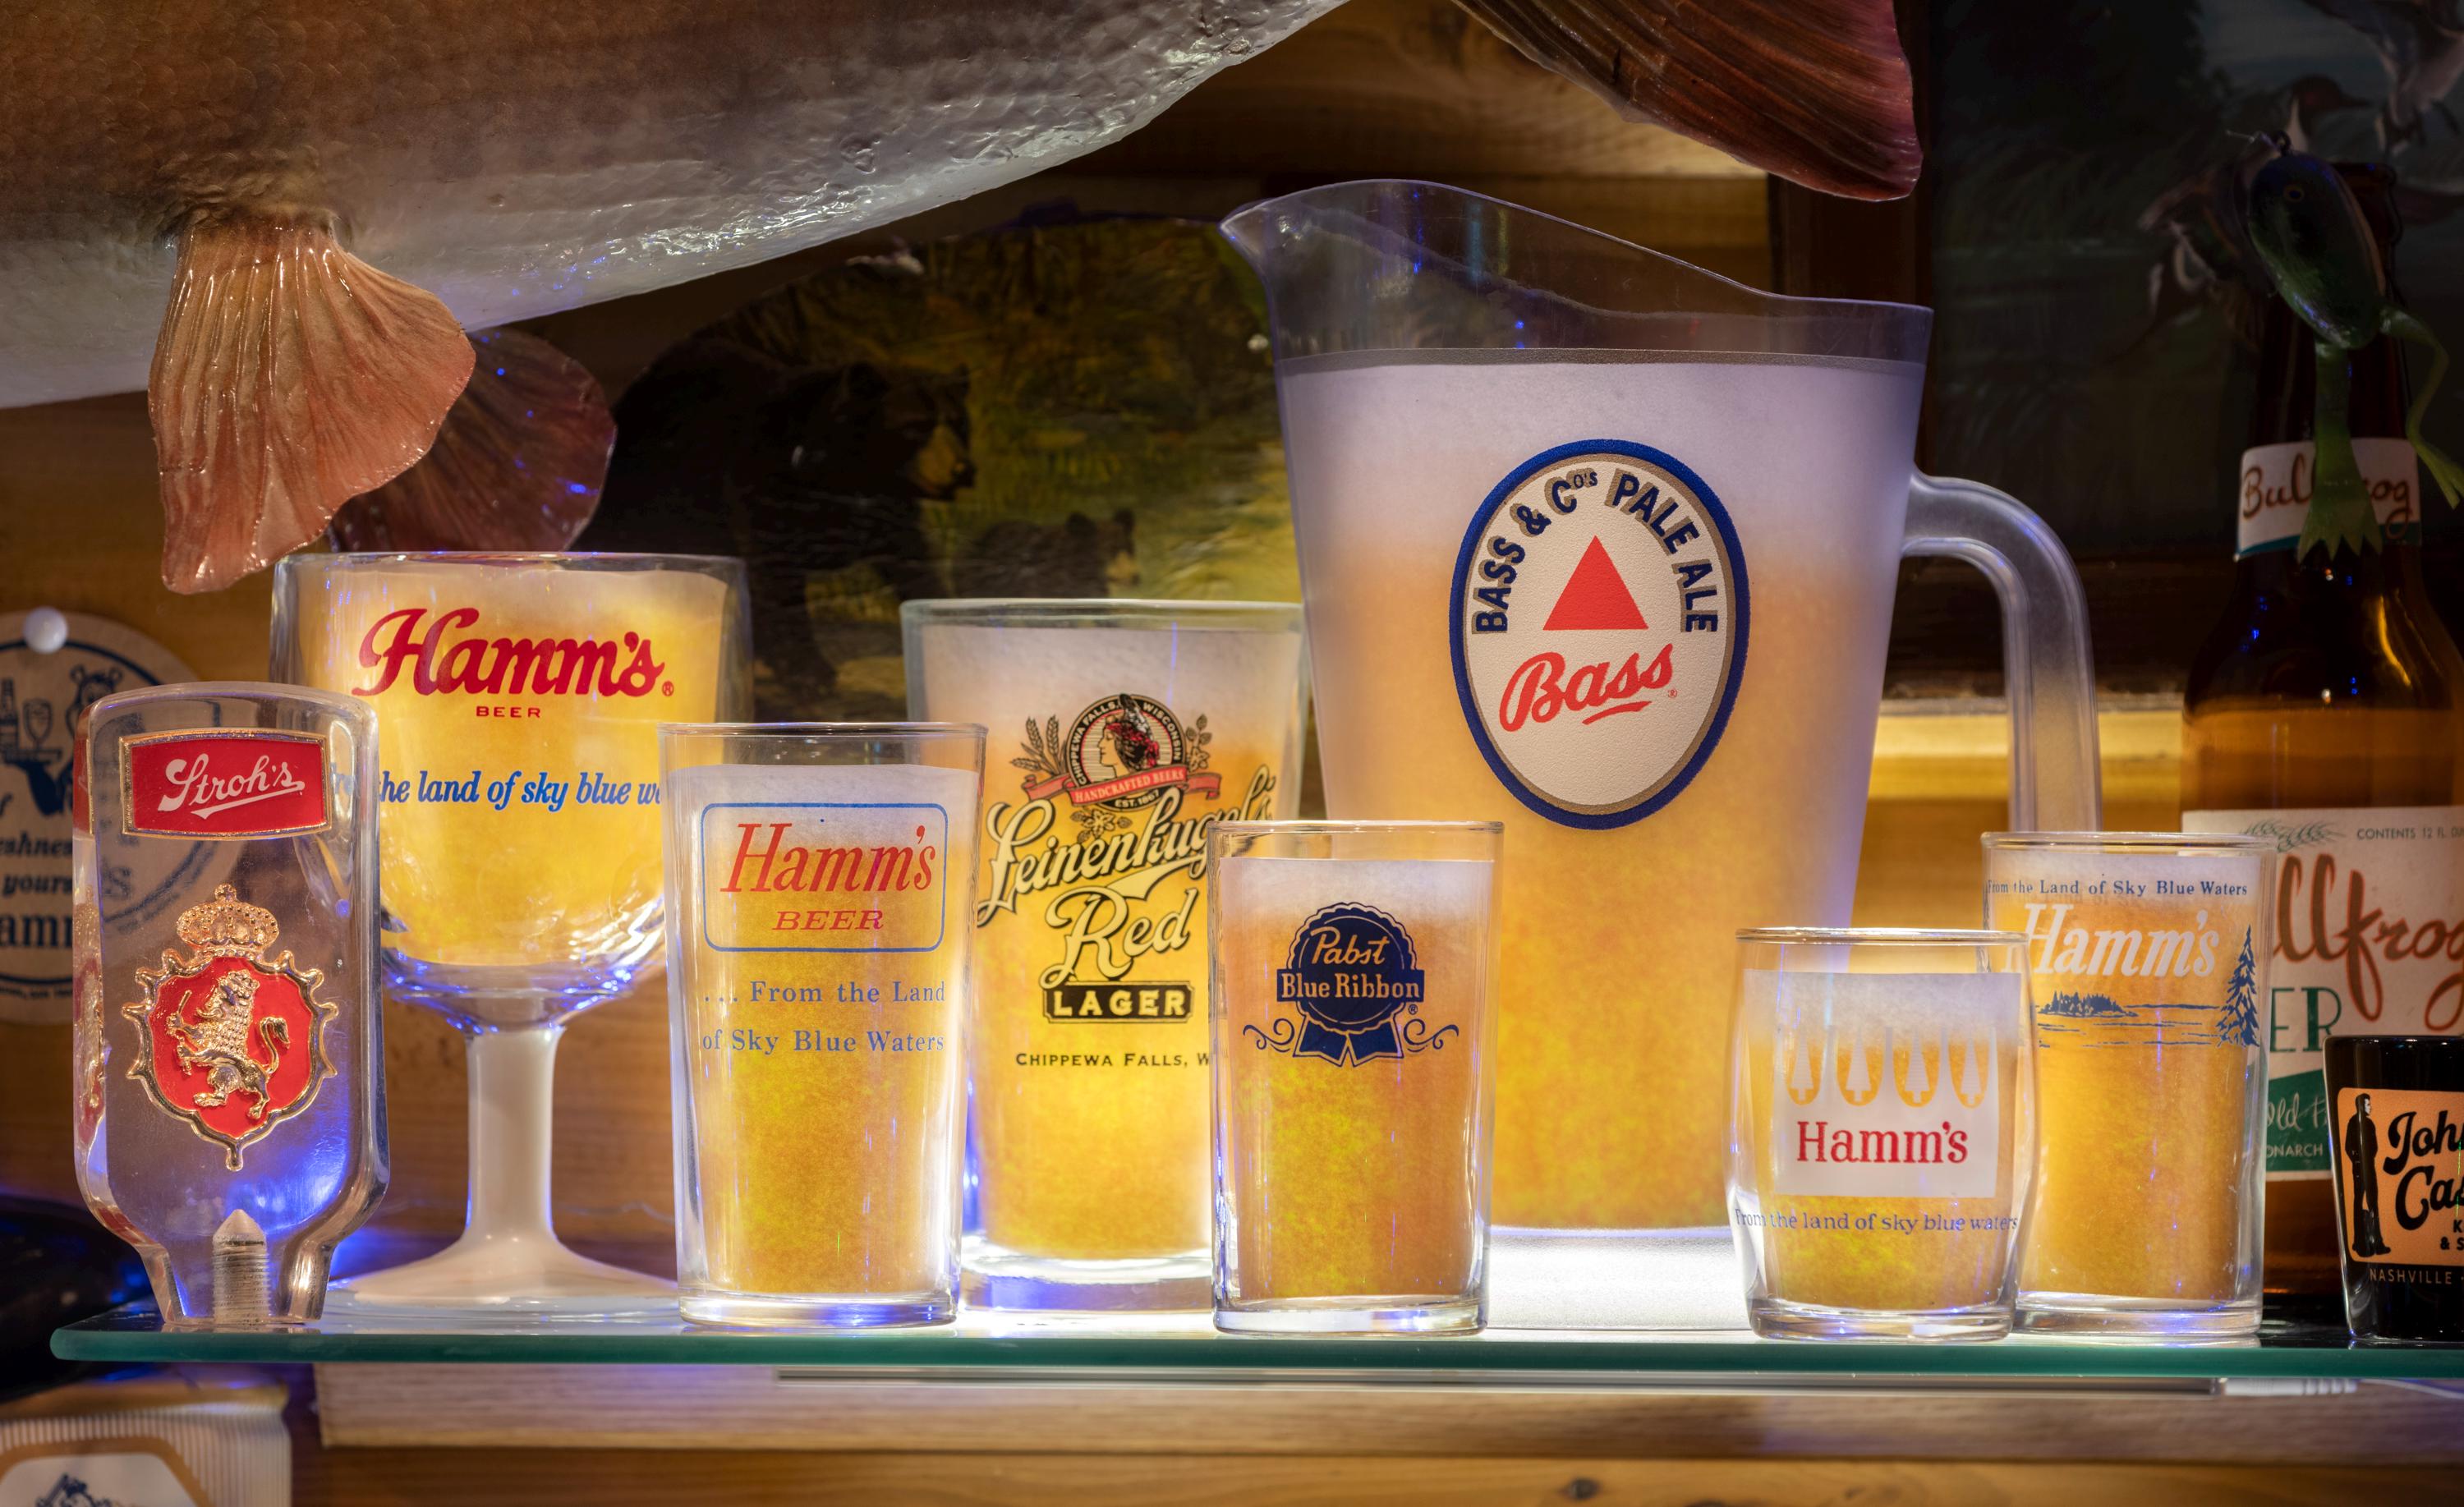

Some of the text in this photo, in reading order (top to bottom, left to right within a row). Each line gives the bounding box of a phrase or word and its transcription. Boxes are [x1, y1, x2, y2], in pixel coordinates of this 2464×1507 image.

[1472, 535, 1525, 634] BASS
[1510, 503, 1551, 537] &
[1604, 469, 1700, 556] PALE
[1671, 558, 1718, 632] ALE
[352, 608, 665, 696] Hamm's
[1499, 643, 1673, 732] Bass
[476, 705, 541, 718] BEER
[1070, 727, 1087, 784] CHIPPEWA
[1143, 701, 1182, 760] WISCONSIN
[157, 753, 306, 816] Stroh's
[379, 770, 411, 802] he
[417, 770, 481, 802] land
[487, 770, 522, 810] of
[521, 773, 569, 812] sky
[576, 773, 631, 805] blue
[1074, 770, 1184, 802] HANDCRAFTED BEERS
[1138, 789, 1160, 806] 1867
[2356, 827, 2416, 839] CONTENTS
[719, 823, 935, 893] Hamm's
[1988, 880, 2248, 897] From the Land of Sky Blue Waters
[772, 910, 884, 931] BEER
[1040, 886, 1198, 990] Red
[1311, 926, 1390, 966] Pabst
[2002, 903, 2220, 977] Hamm's
[751, 981, 823, 1003] From
[838, 981, 880, 1004] the
[893, 981, 945, 1002] Land
[1281, 972, 1420, 999] Blue Ribbon
[1053, 990, 1187, 1018] LAGER
[702, 1029, 945, 1055] of Sky Blue Waters
[1016, 1052, 1113, 1067] CHIPPEWA
[1124, 1052, 1188, 1068] FALLS,
[1796, 1121, 1969, 1164] Hamm's
[2266, 1142, 2324, 1159] ONARCH
[2383, 1110, 2464, 1175] Joh
[1735, 1208, 2018, 1235] From the land of sky blue waters
[2370, 1268, 2453, 1284] NASHVILLE
